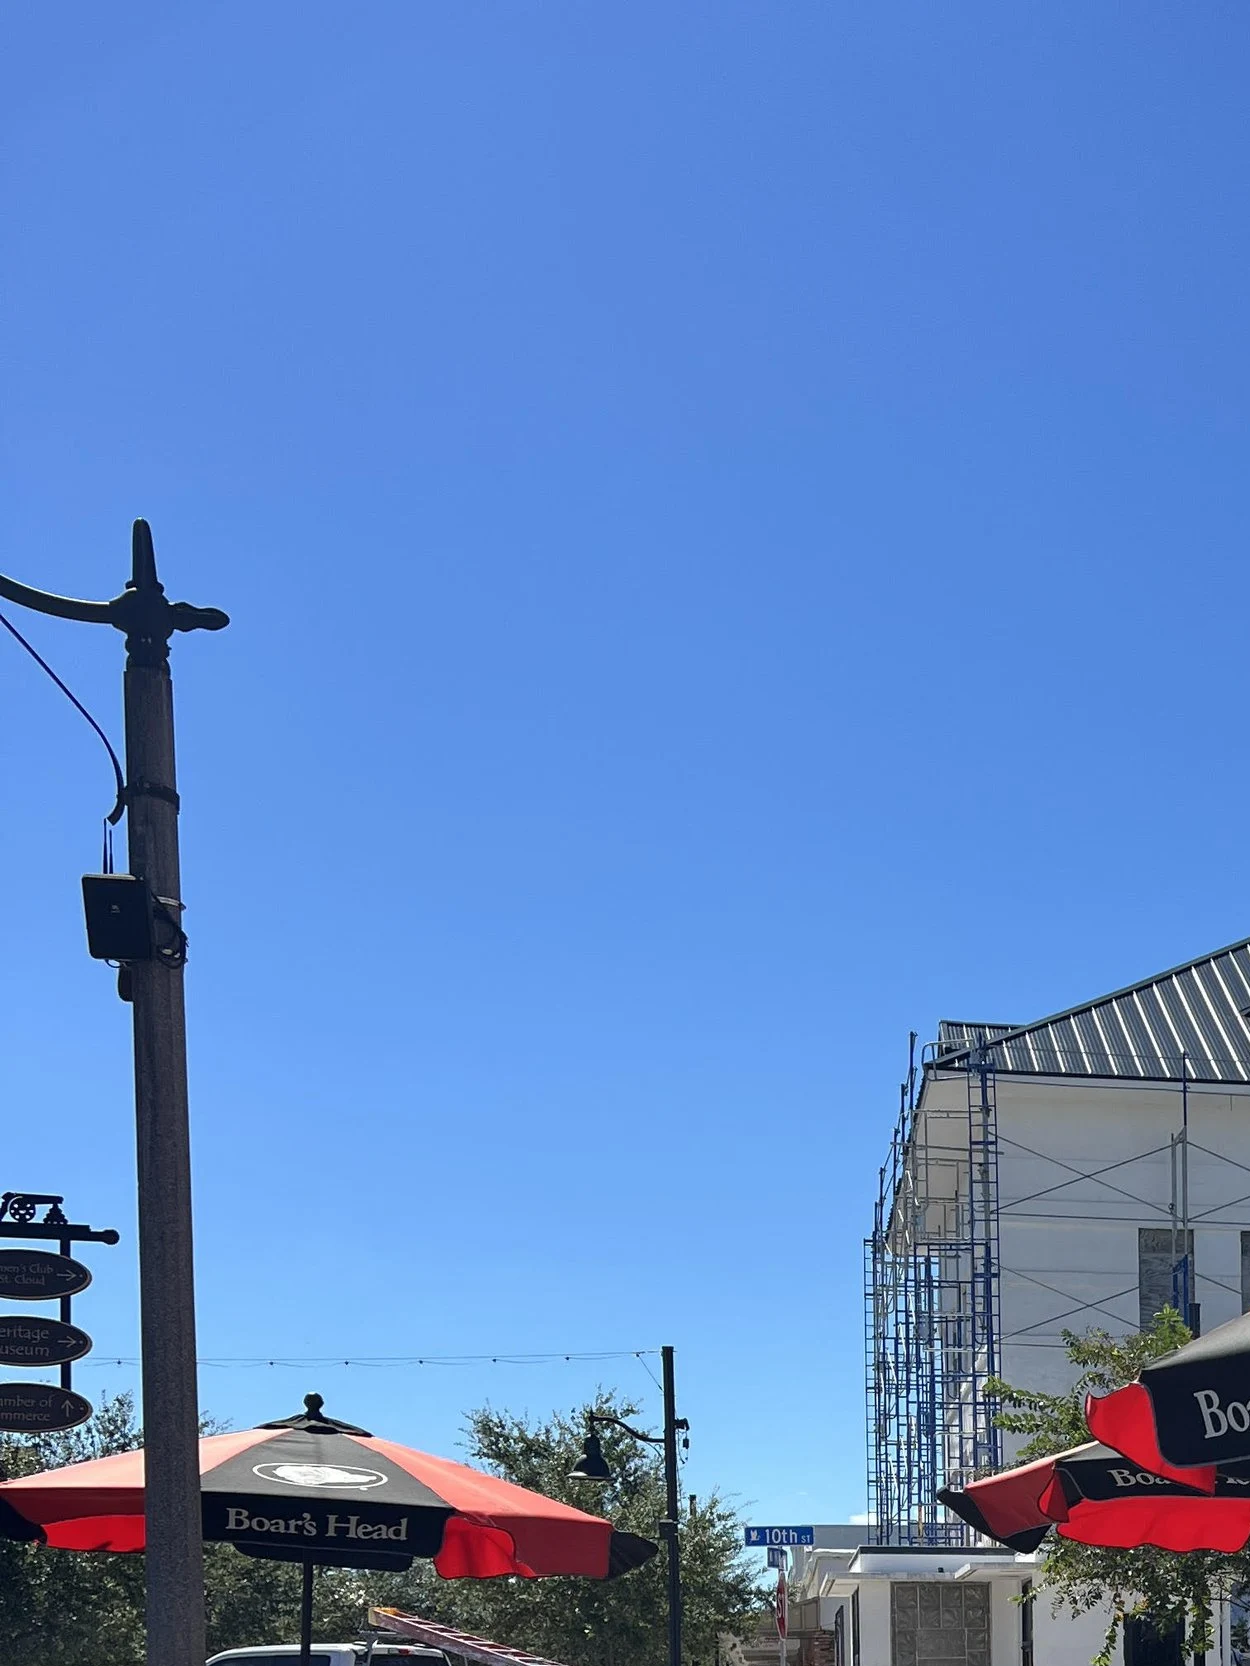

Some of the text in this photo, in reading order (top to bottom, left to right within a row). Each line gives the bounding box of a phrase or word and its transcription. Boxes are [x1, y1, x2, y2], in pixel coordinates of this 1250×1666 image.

[29, 1263, 55, 1274] Club
[14, 1274, 46, 1286] Cloud
[39, 1394, 57, 1408] of
[224, 1506, 409, 1542] Boar's Head
[764, 1528, 811, 1544] 10th ST
